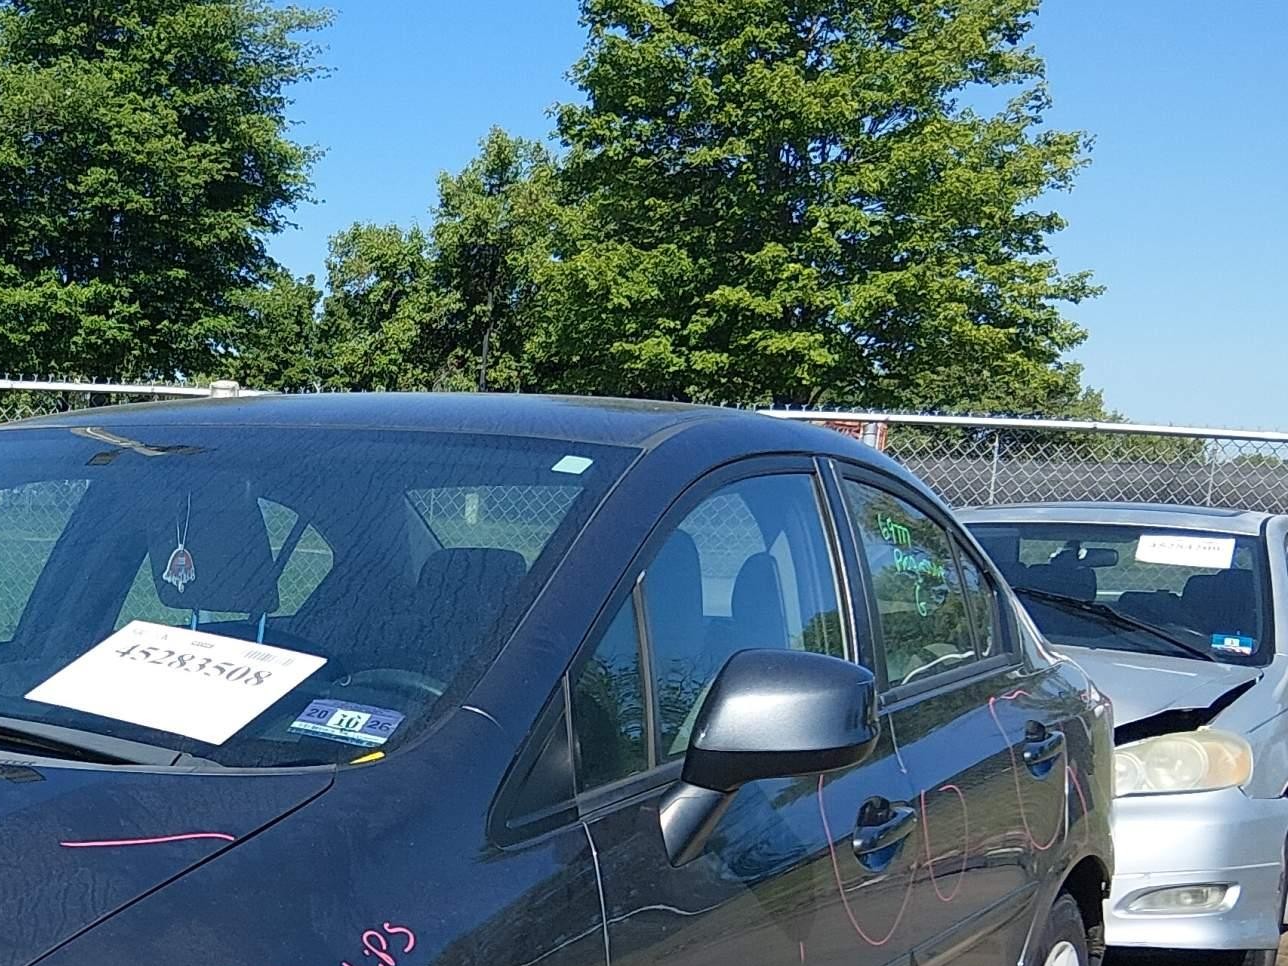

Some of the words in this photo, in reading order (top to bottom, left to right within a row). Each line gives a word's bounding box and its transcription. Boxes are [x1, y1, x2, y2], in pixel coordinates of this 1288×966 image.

[115, 643, 273, 687] 45283508
[307, 708, 329, 720] 20
[367, 719, 393, 733] 26
